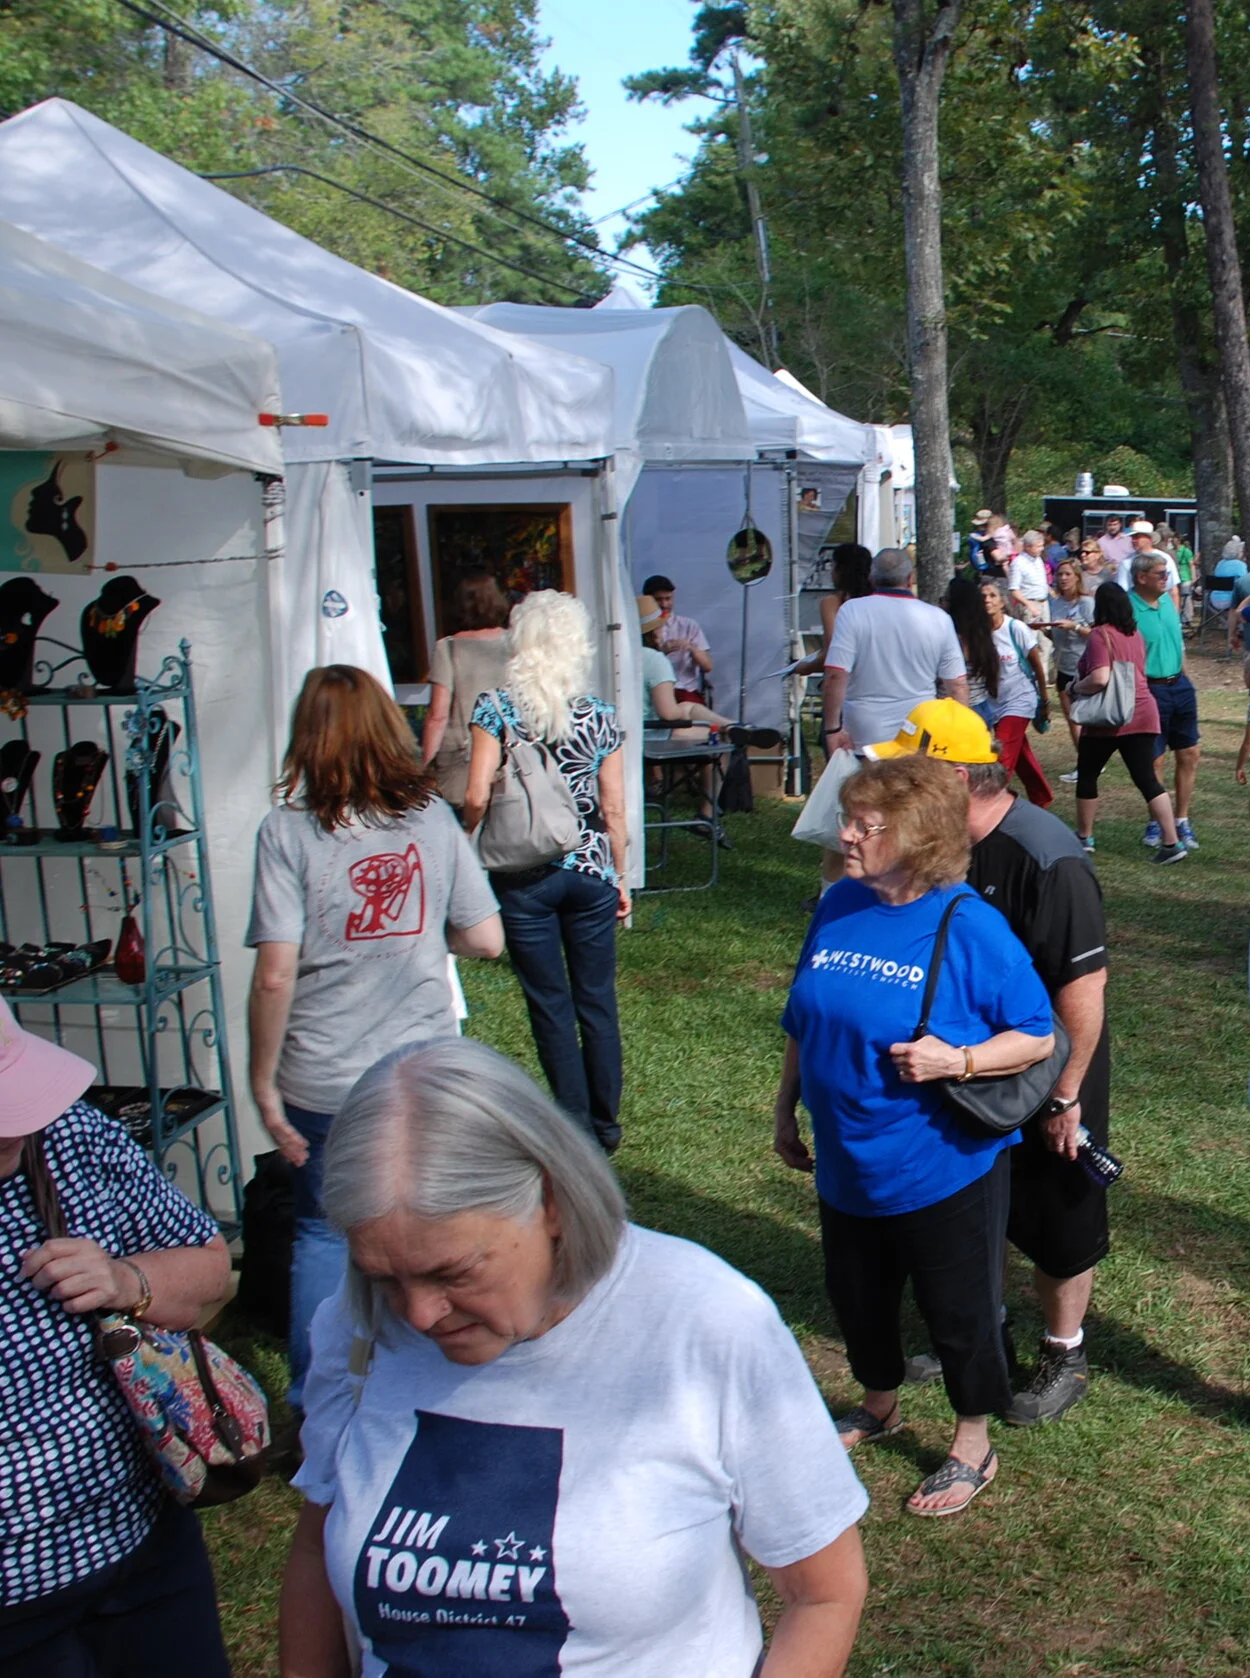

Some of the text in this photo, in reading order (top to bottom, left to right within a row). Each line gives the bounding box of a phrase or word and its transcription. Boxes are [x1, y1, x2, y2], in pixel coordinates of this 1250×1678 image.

[828, 950, 924, 982] WESTWOOD
[372, 1506, 450, 1550] JIM
[366, 1546, 547, 1603] TOOMEY
[378, 1602, 431, 1624] House
[436, 1608, 499, 1626] District
